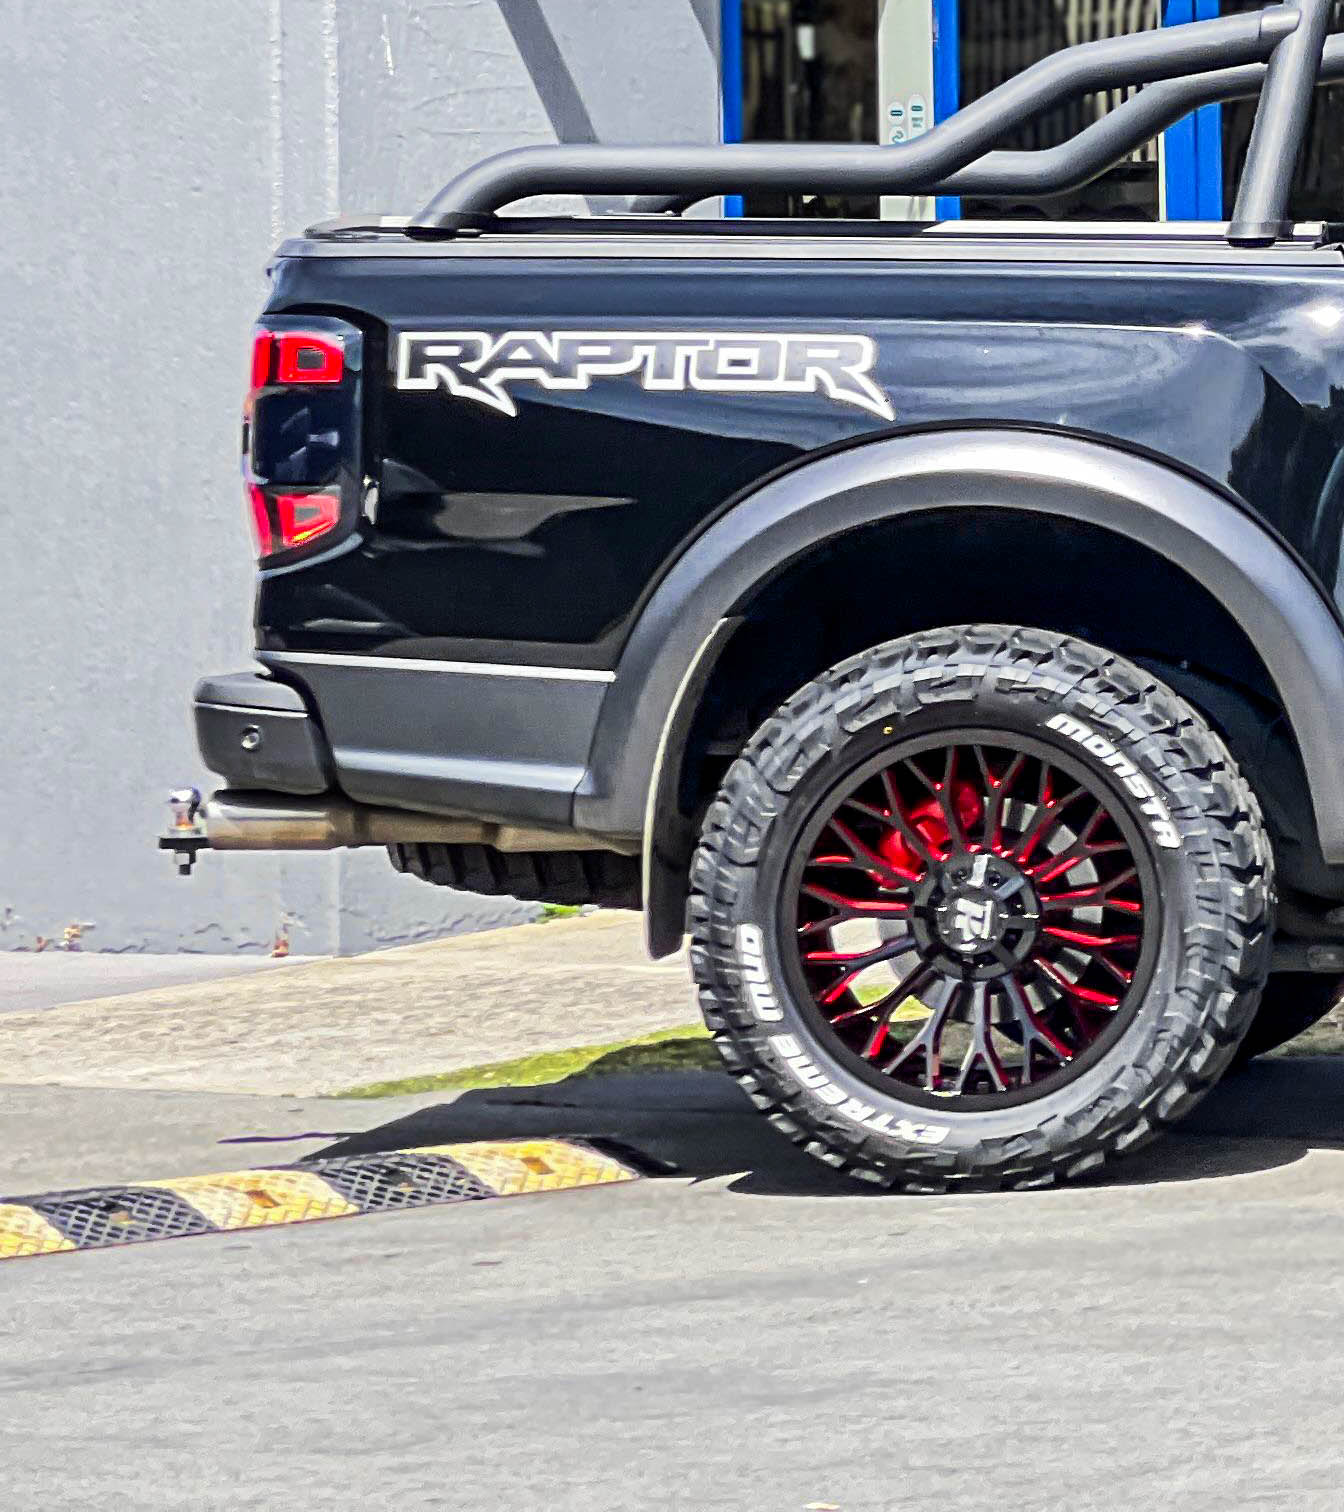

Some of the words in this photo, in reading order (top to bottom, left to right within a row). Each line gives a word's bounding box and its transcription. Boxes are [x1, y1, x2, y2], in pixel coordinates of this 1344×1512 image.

[396, 329, 896, 423] RAPTOR
[1045, 712, 1182, 849] MONSTA
[737, 922, 784, 1022] MUD
[767, 1034, 951, 1145] EXTREME
